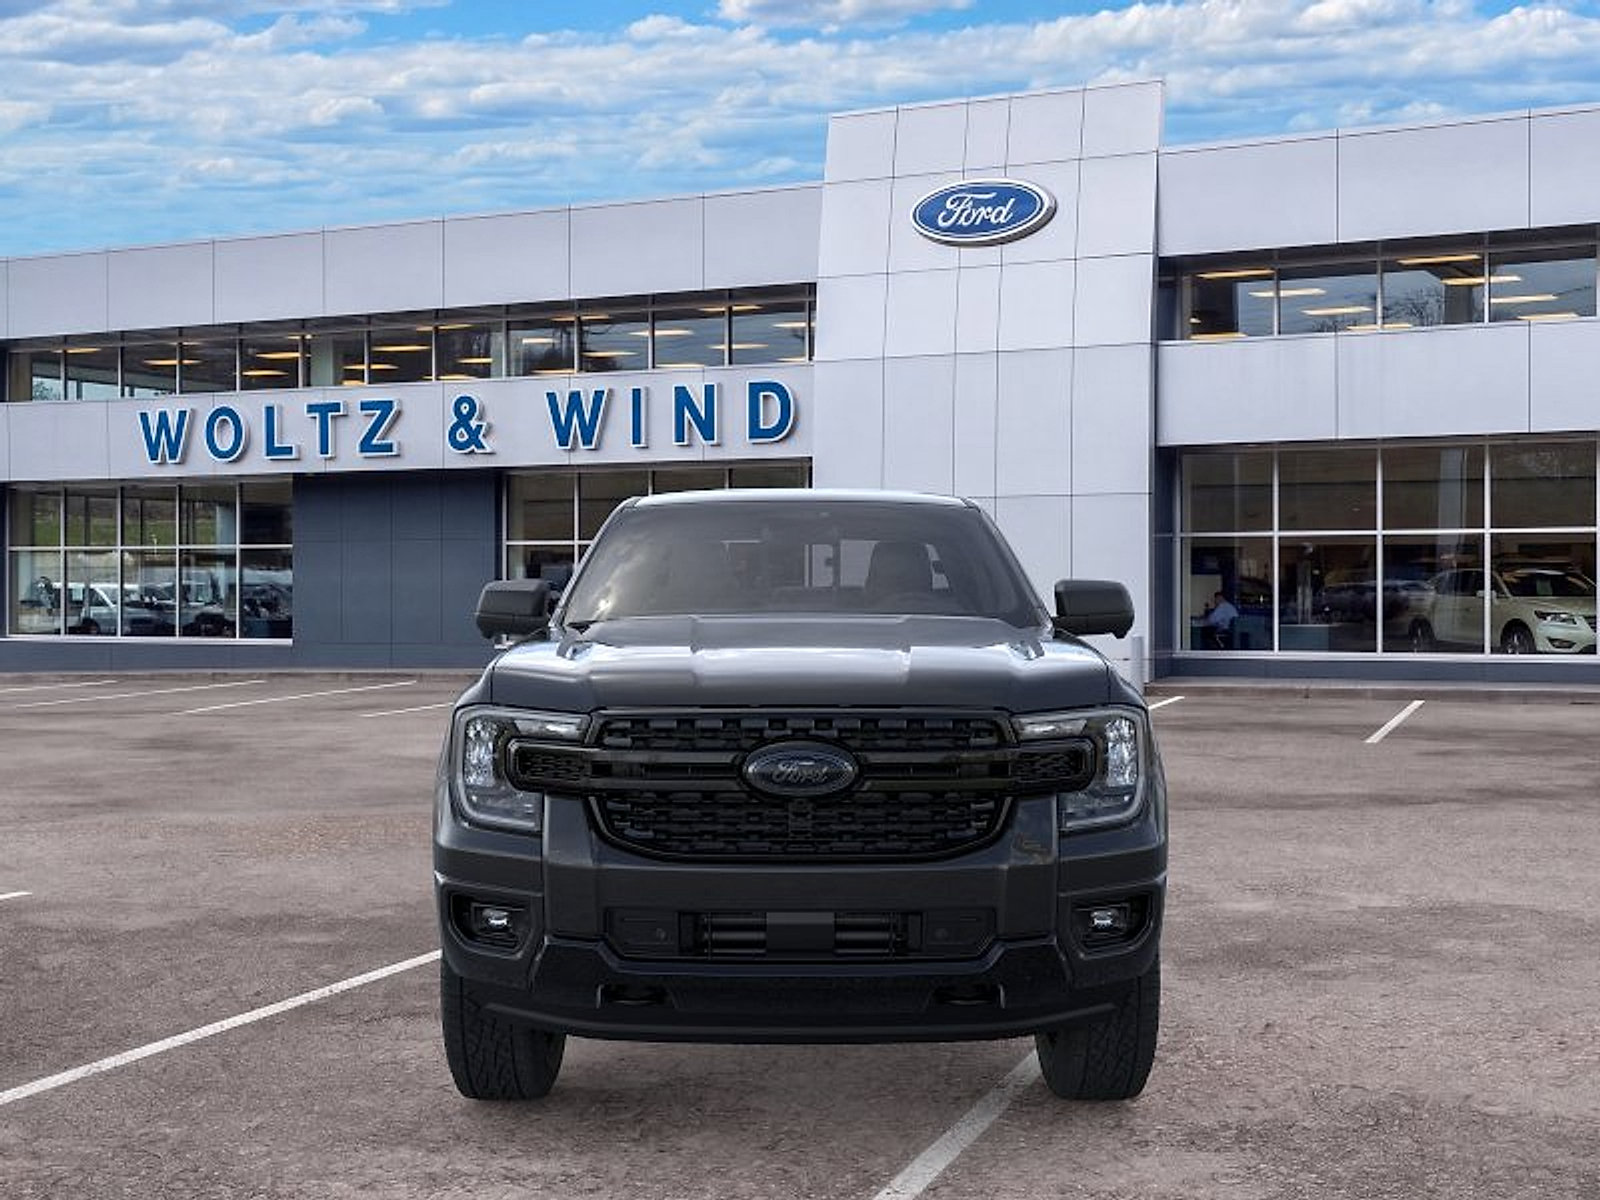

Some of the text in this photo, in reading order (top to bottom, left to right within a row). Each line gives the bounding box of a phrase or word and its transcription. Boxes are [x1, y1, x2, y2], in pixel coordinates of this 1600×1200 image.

[937, 192, 1015, 227] Ford
[138, 379, 795, 464] WOLTZ & WIND
[772, 760, 828, 783] Ford
